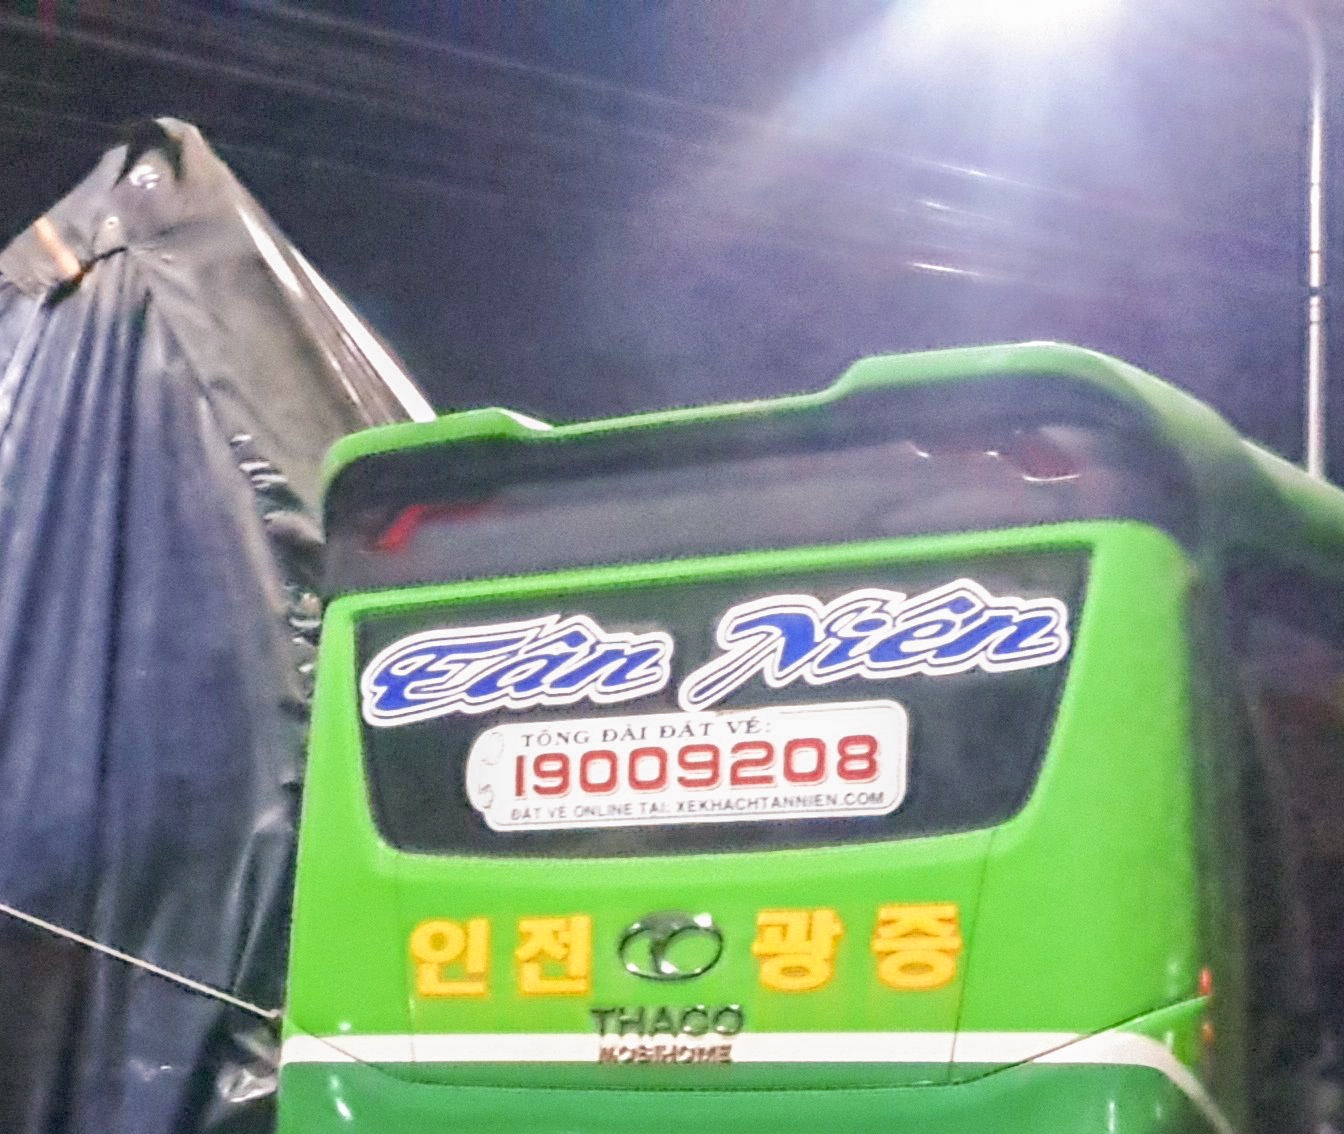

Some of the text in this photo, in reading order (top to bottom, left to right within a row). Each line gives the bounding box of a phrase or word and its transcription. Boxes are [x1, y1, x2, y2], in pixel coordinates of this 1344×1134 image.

[514, 734, 879, 797] 19009208
[574, 803, 632, 818] ONLINE
[591, 1004, 745, 1037] THACO
